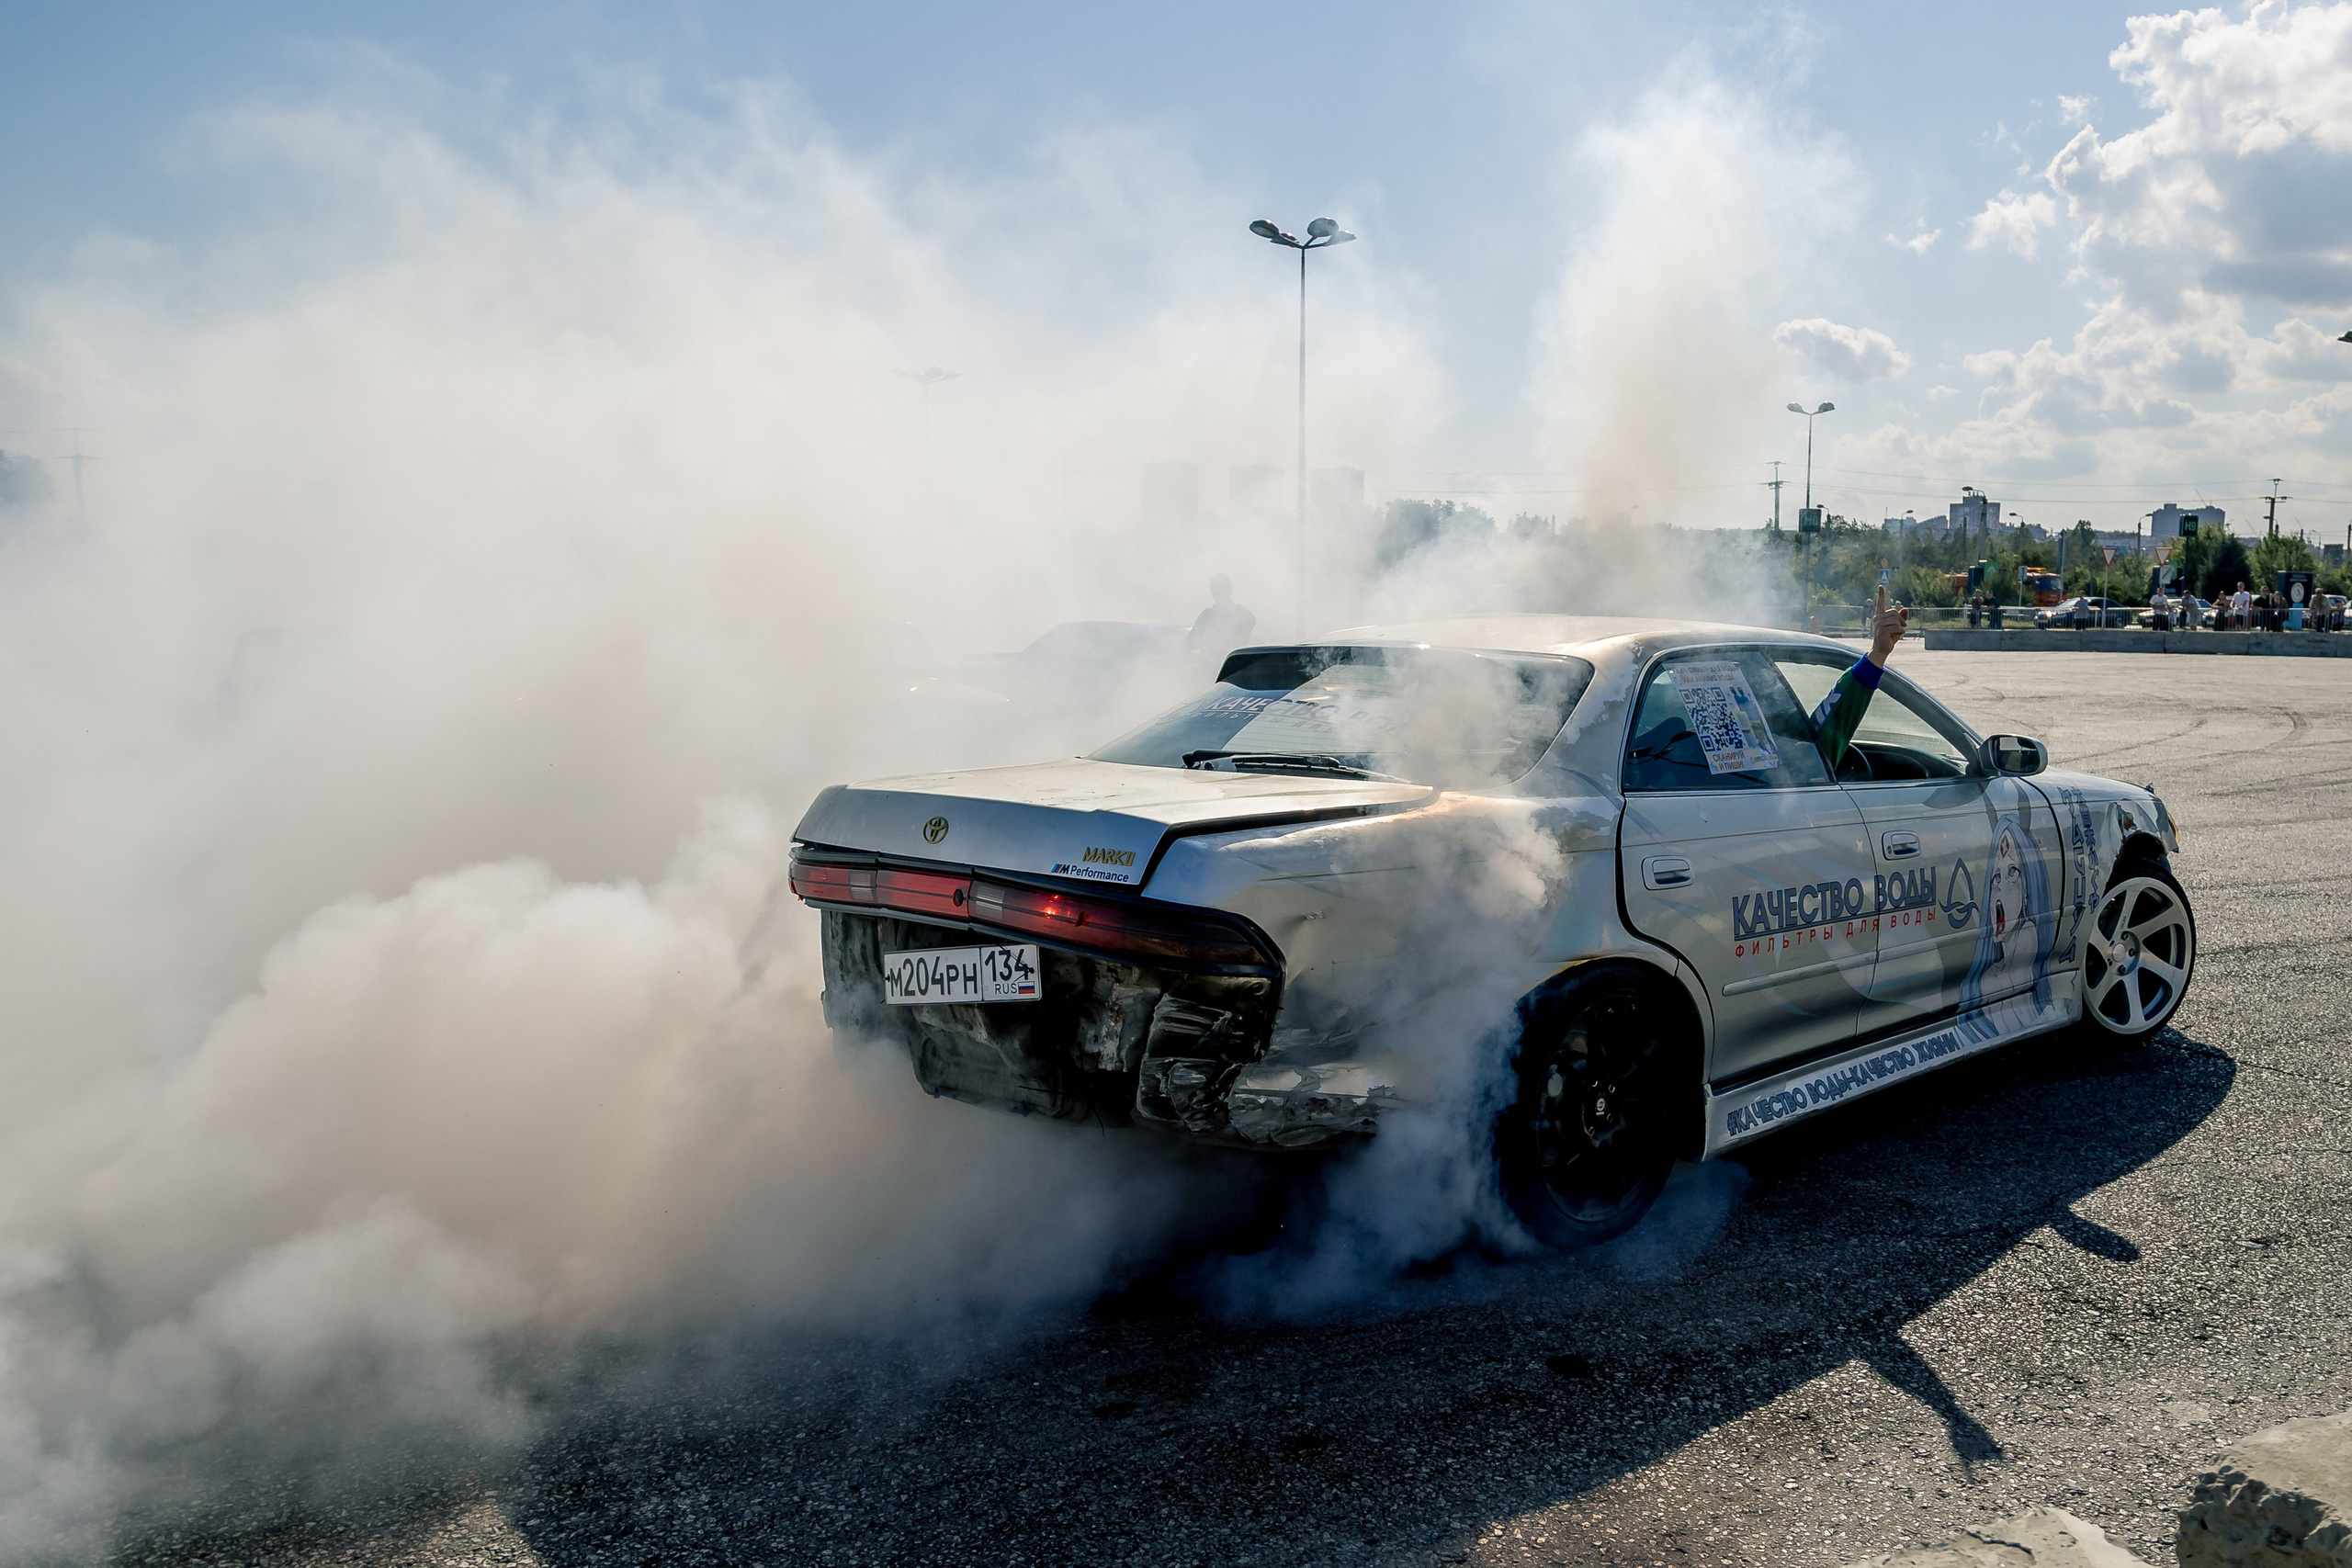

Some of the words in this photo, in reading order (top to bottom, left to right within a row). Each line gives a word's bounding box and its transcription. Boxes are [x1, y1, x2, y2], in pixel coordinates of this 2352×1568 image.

[2184, 521, 2197, 531] H9
[1069, 864, 1129, 882] Performance
[1732, 877, 1864, 936] КАЧЕСТВО
[1873, 866, 1937, 910] ВОДЫ
[1735, 925, 1833, 959] ФИЛЬТРЫ
[1846, 919, 1879, 938] ДЛЯ
[1890, 908, 1936, 929] ВОДЫ
[984, 948, 1029, 982] 134
[994, 982, 1017, 995] RUS
[1727, 1087, 1807, 1136] #КАЧЕСТВО
[1911, 1032, 1961, 1064] ЖИЗНИ
